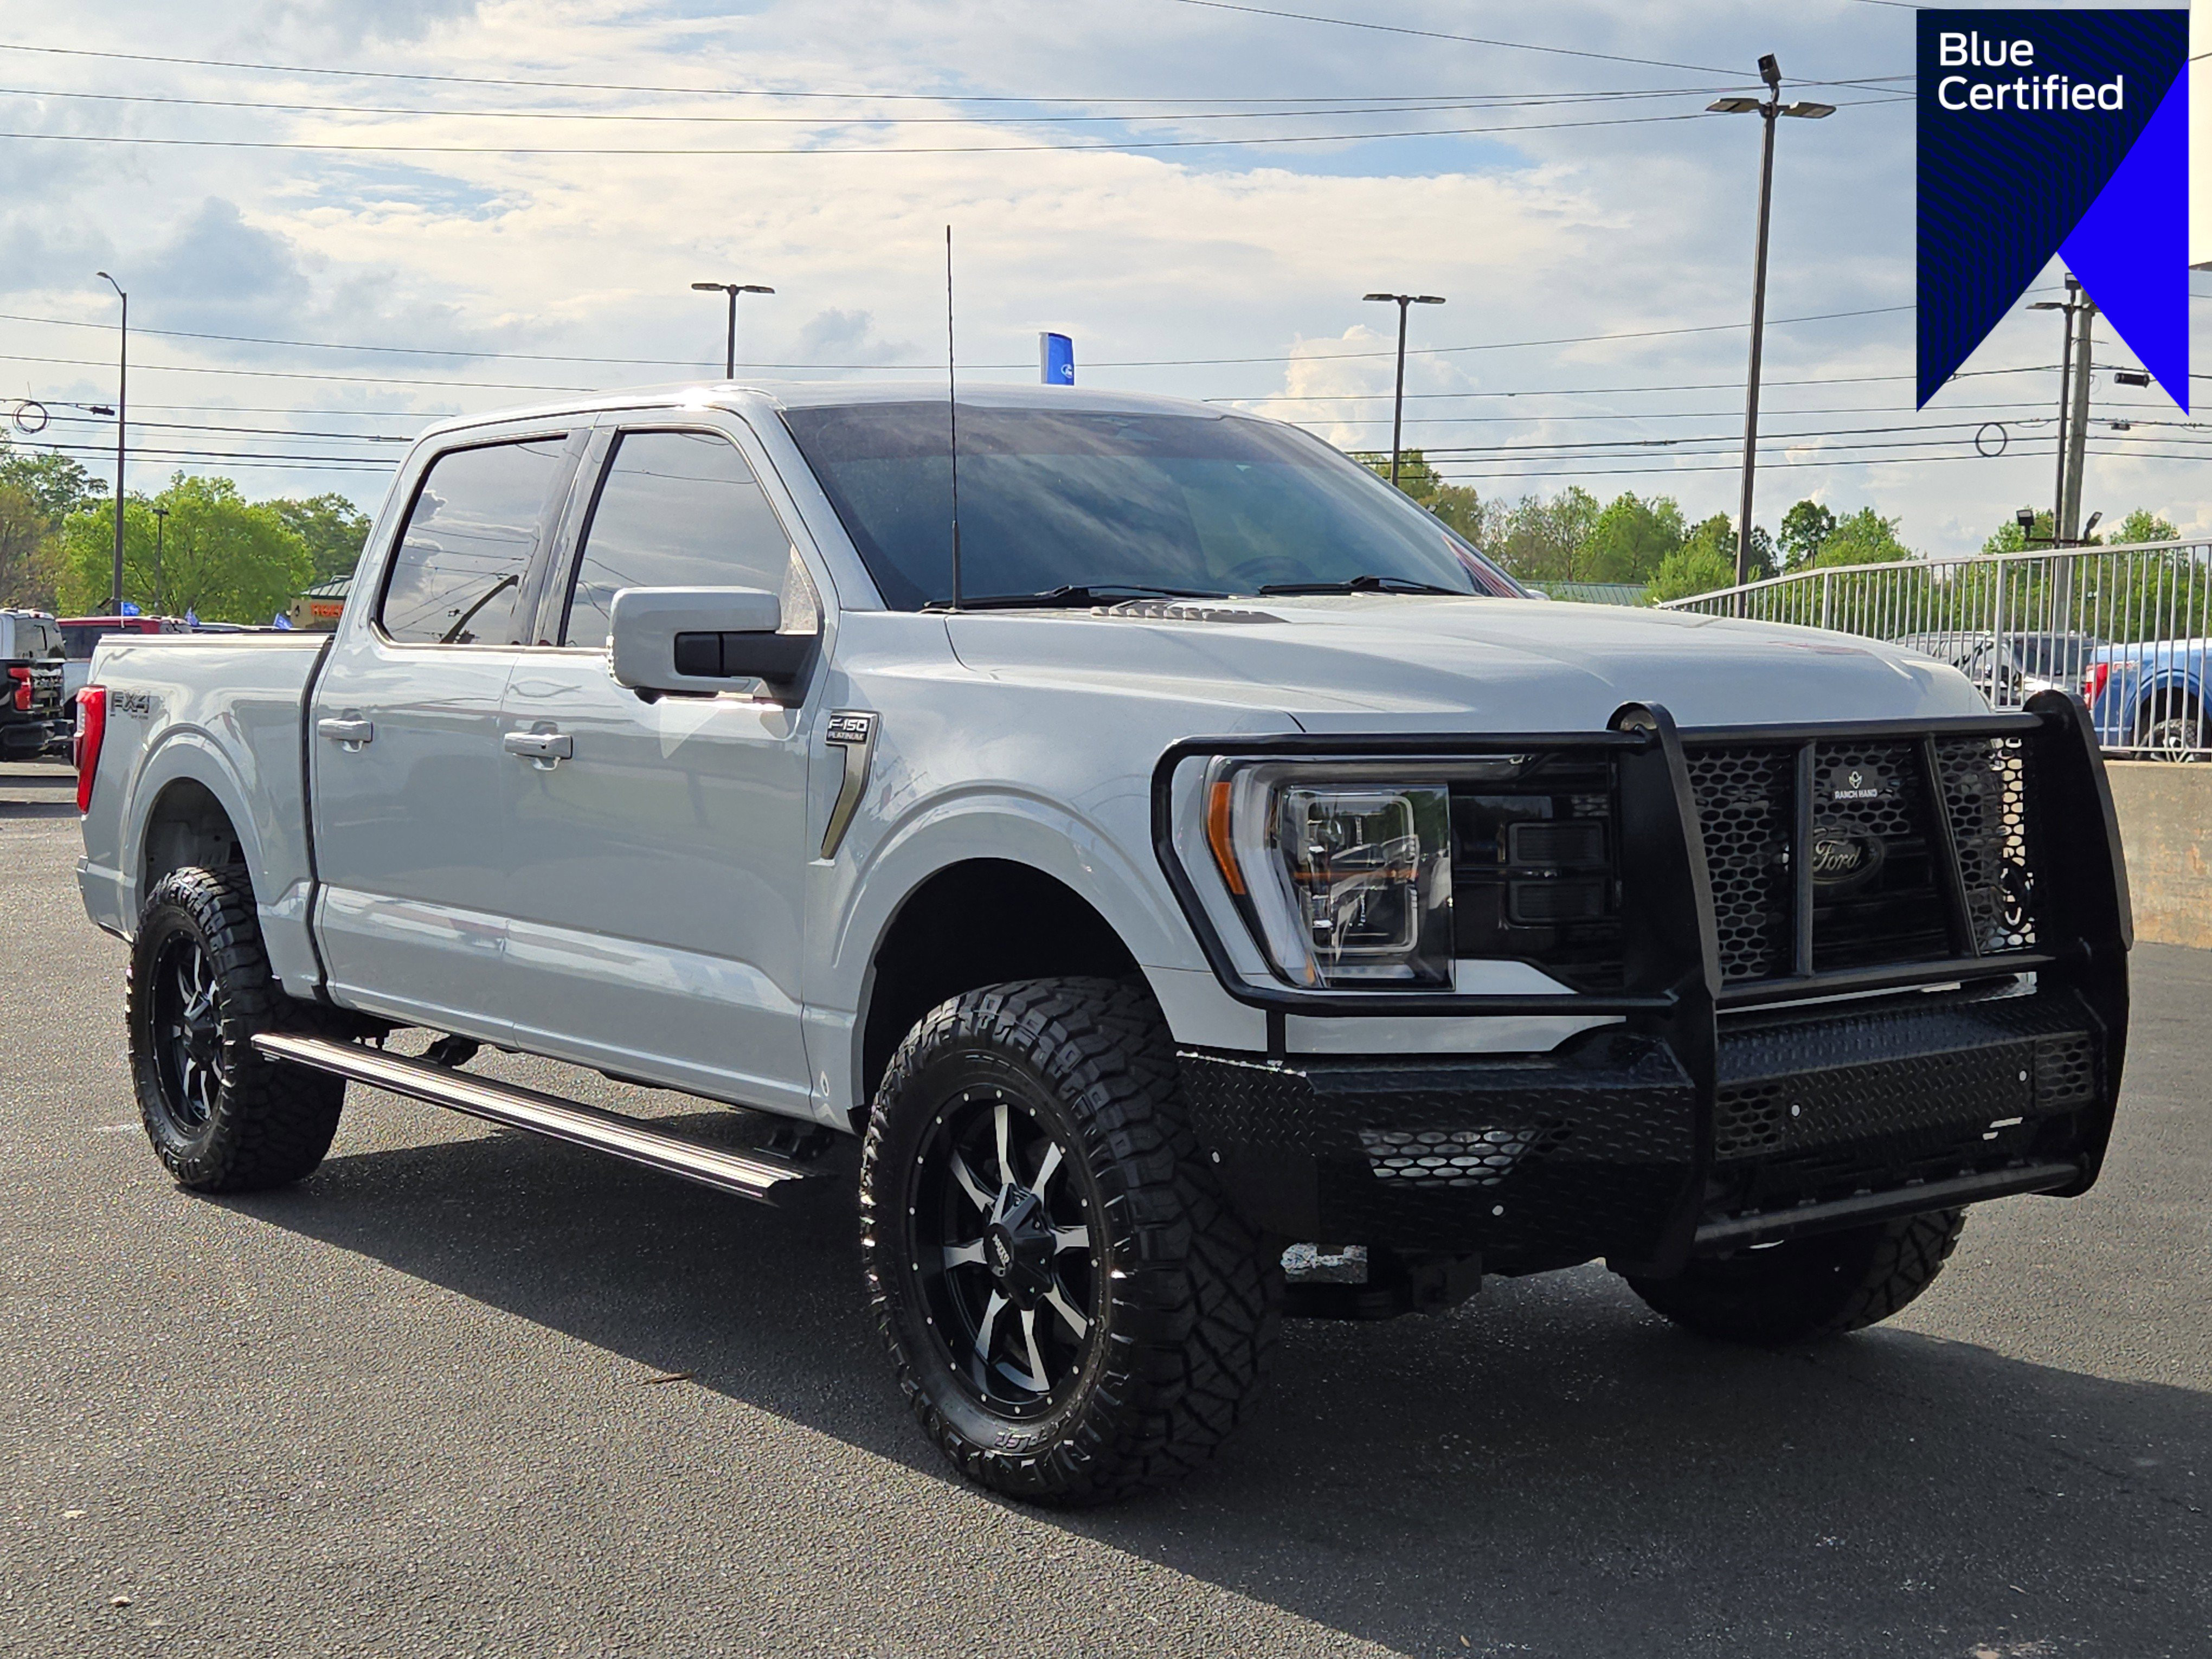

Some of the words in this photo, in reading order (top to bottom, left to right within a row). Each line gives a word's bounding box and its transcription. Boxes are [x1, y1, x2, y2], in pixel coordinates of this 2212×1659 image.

[110, 689, 150, 717] FX4
[828, 718, 868, 732] F-150
[1835, 790, 1857, 800] RANCH
[1859, 788, 1877, 798] HAND
[1812, 840, 1861, 872] Ford
